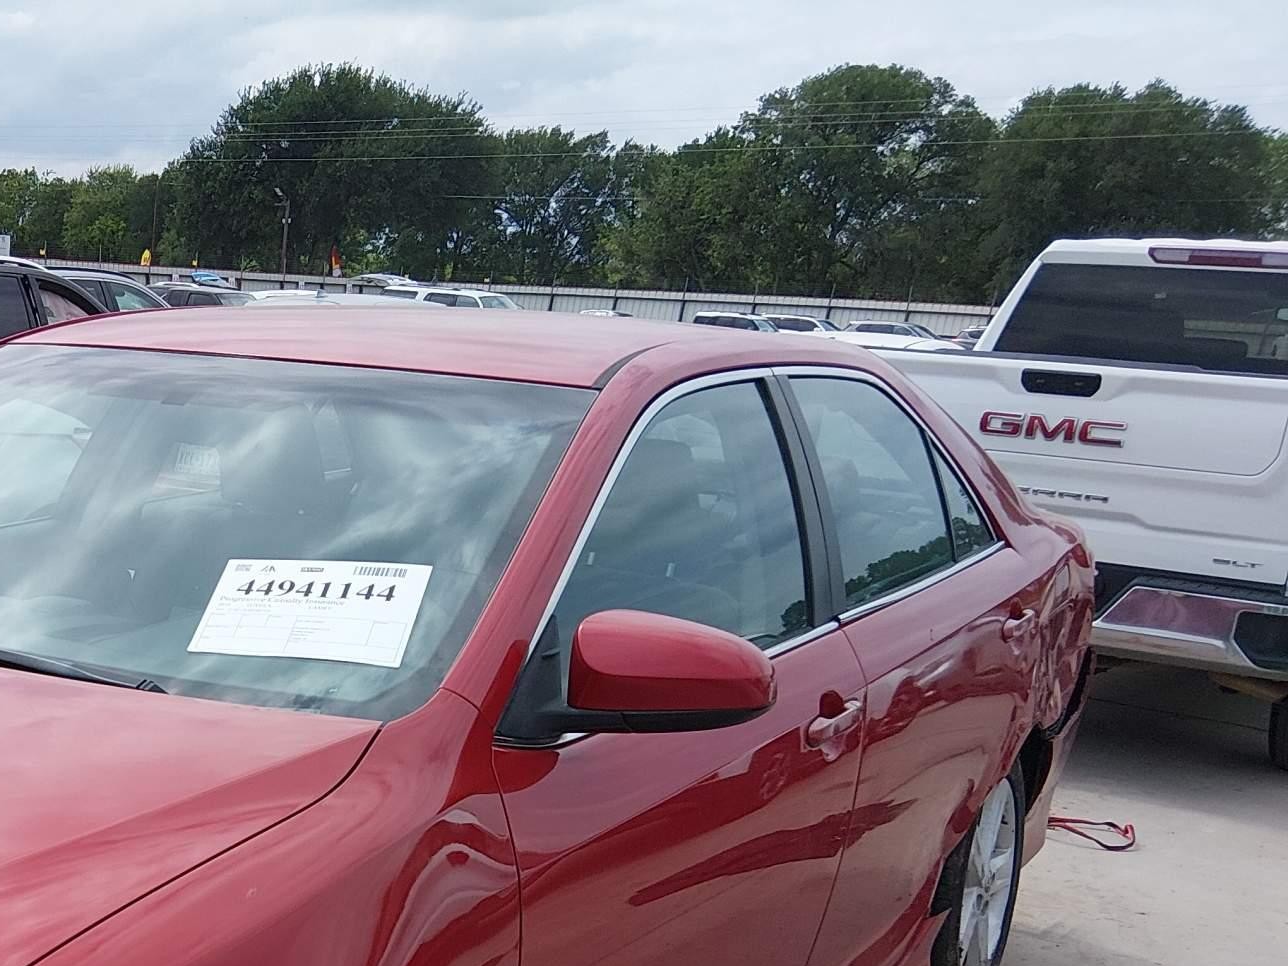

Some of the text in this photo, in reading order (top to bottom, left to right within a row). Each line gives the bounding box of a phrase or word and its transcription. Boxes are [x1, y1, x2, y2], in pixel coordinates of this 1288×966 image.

[979, 410, 1128, 448] GMC
[1213, 558, 1264, 569] SLT
[237, 578, 396, 602] 44941144
